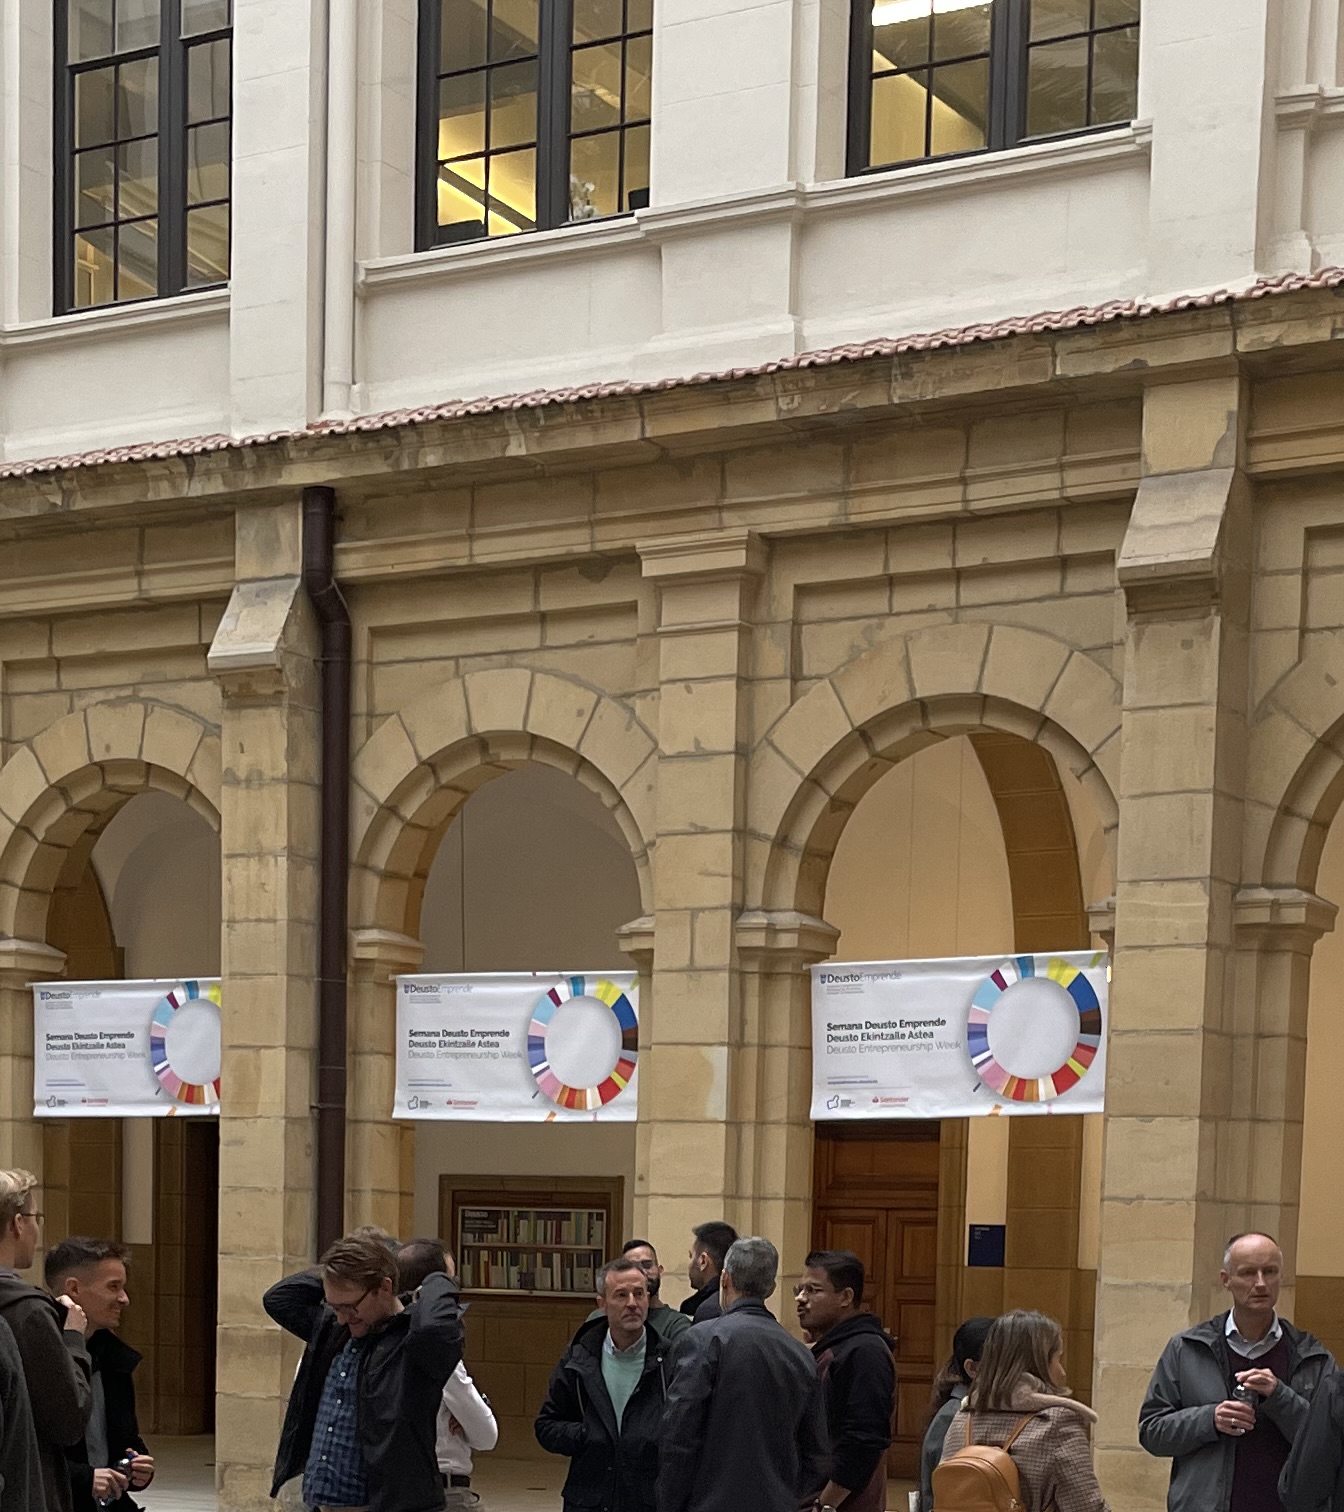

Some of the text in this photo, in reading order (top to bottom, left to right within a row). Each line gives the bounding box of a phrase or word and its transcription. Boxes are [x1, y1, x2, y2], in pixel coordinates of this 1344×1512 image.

[827, 1017, 947, 1031] Semana Deusto Emprende
[409, 1029, 510, 1039] Semana Deusto Emprende
[827, 1034, 859, 1043] Deusto
[908, 1030, 934, 1040] Astea
[408, 1040, 436, 1048] Deusto
[477, 1040, 500, 1048] Astea
[827, 1040, 962, 1054] Deusto Entrepreneurship Week
[408, 1051, 435, 1059] Deusto
